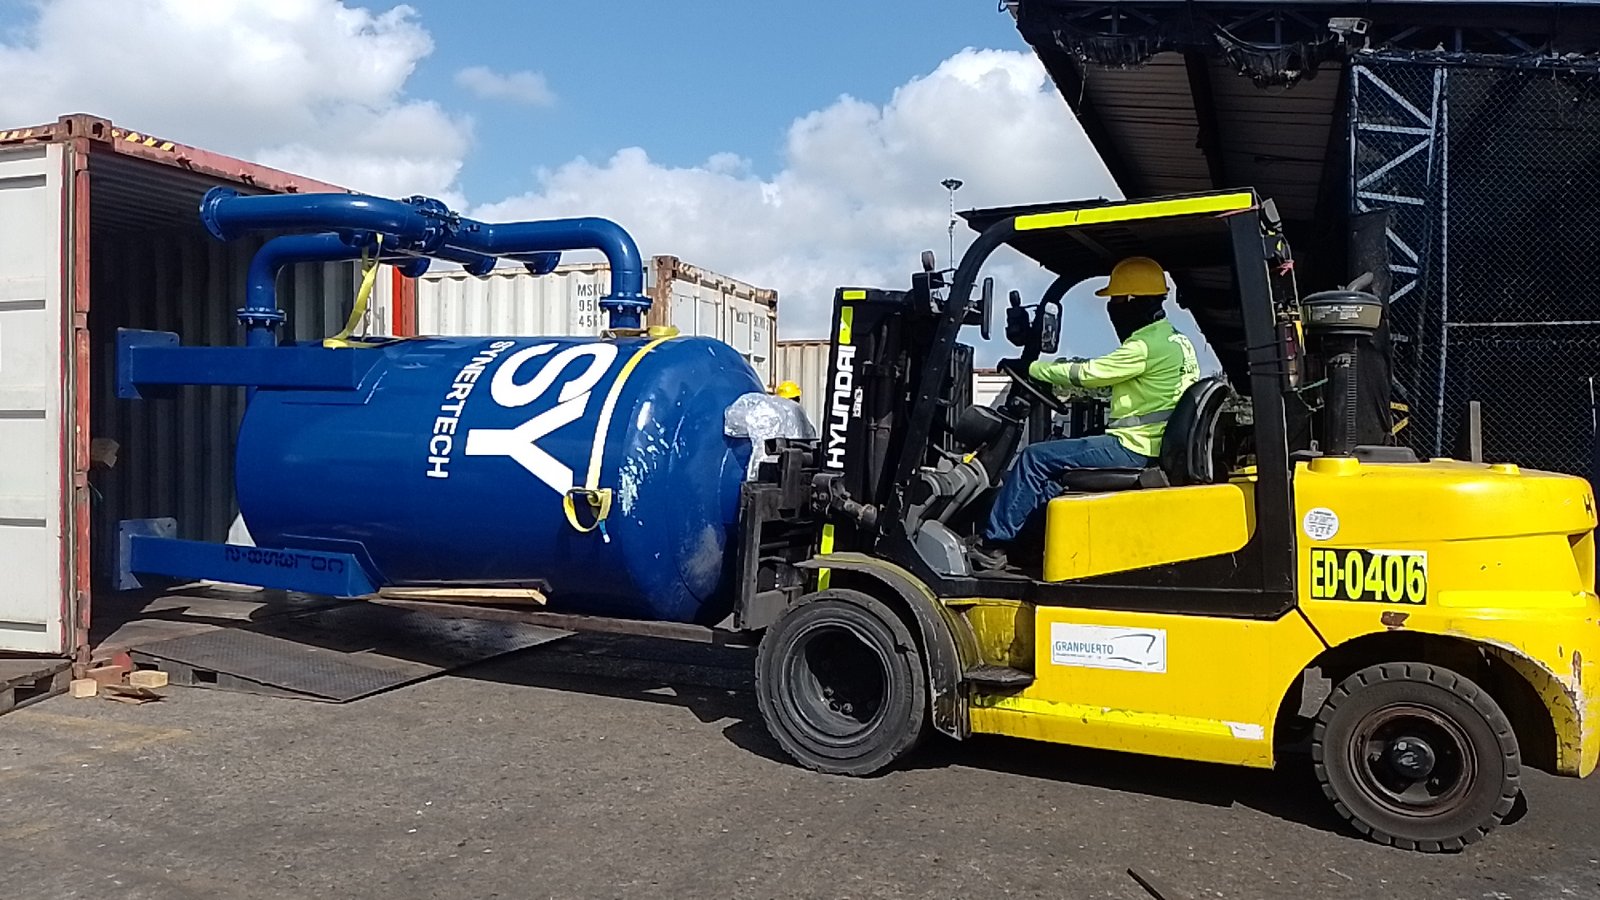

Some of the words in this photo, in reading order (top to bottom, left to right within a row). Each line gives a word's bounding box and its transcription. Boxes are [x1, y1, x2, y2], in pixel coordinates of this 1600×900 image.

[426, 340, 515, 479] SYNERTECH
[465, 342, 619, 496] SY
[826, 345, 856, 469] HYUNDAI
[1311, 550, 1426, 603] ED-0406
[1055, 641, 1114, 655] GRANPUERTO
